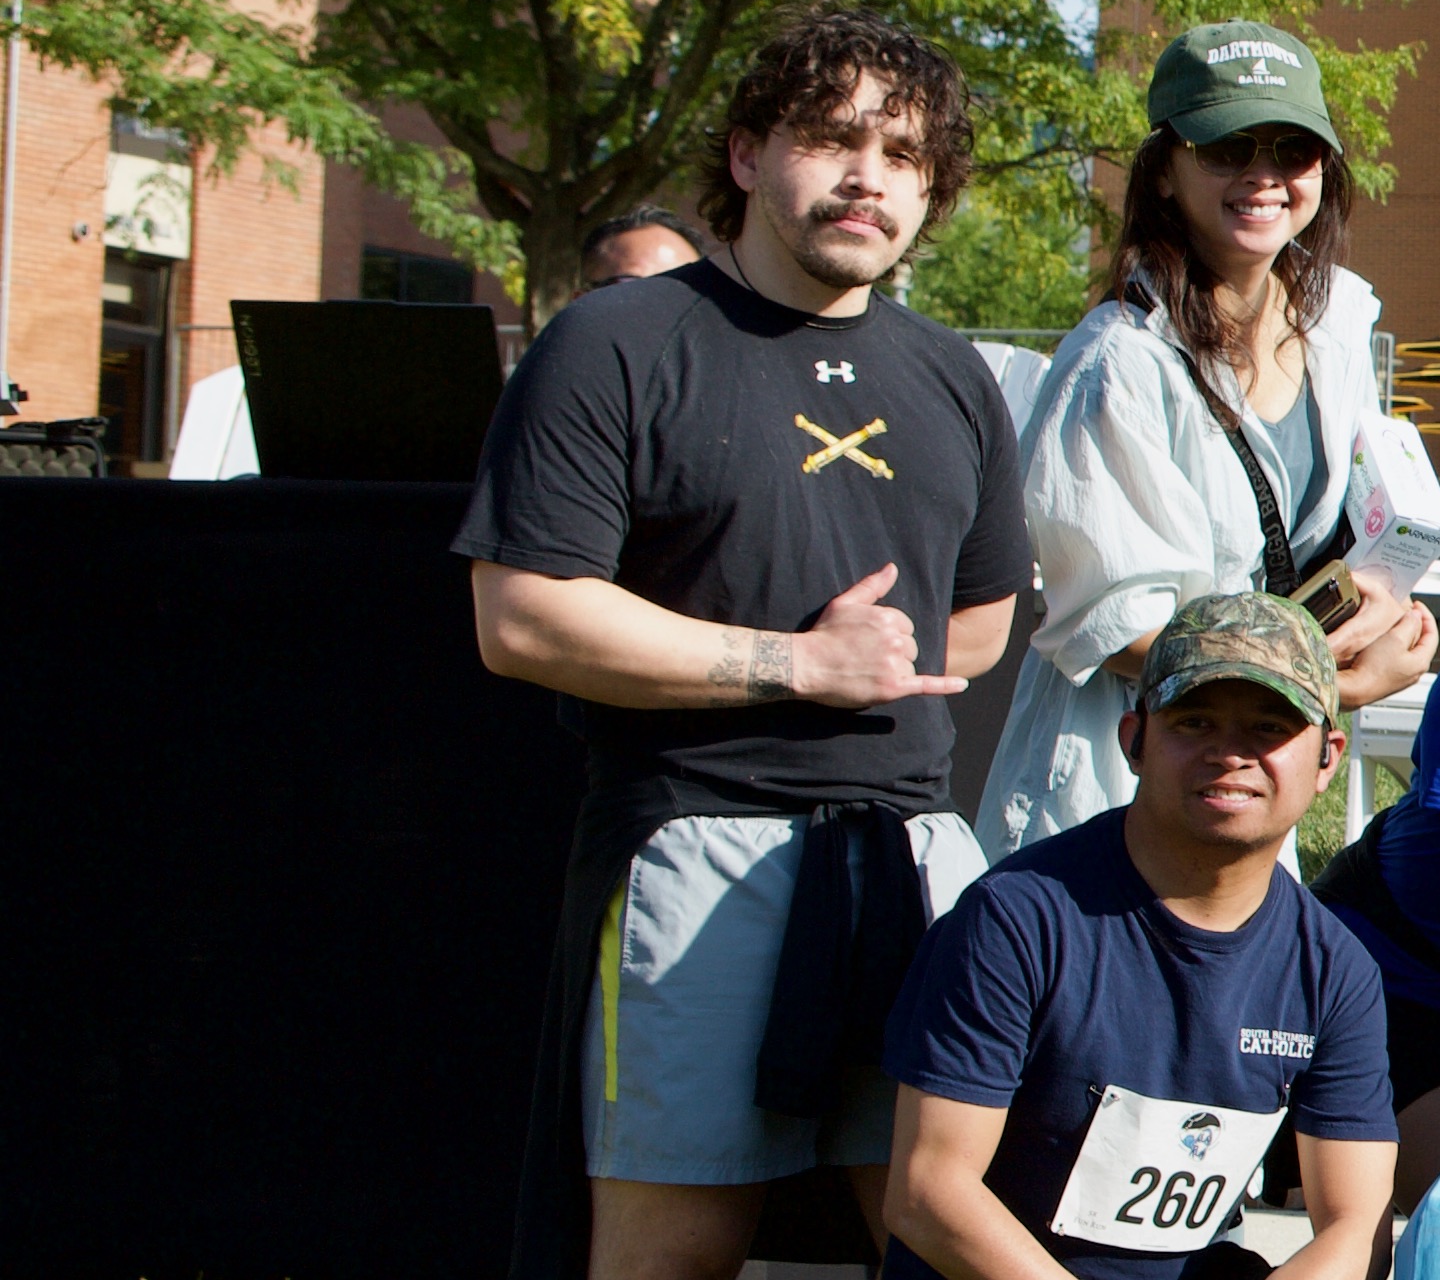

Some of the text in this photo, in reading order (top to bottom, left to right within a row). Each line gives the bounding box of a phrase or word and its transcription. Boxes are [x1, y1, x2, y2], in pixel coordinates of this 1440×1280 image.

[1207, 40, 1303, 69] DARTMOUTH
[1237, 75, 1287, 87] SAILING
[239, 314, 262, 378] LEGION
[1240, 1027, 1270, 1039] SOUTH
[1240, 1037, 1314, 1059] CATHOLIC
[1115, 1166, 1226, 1229] 260
